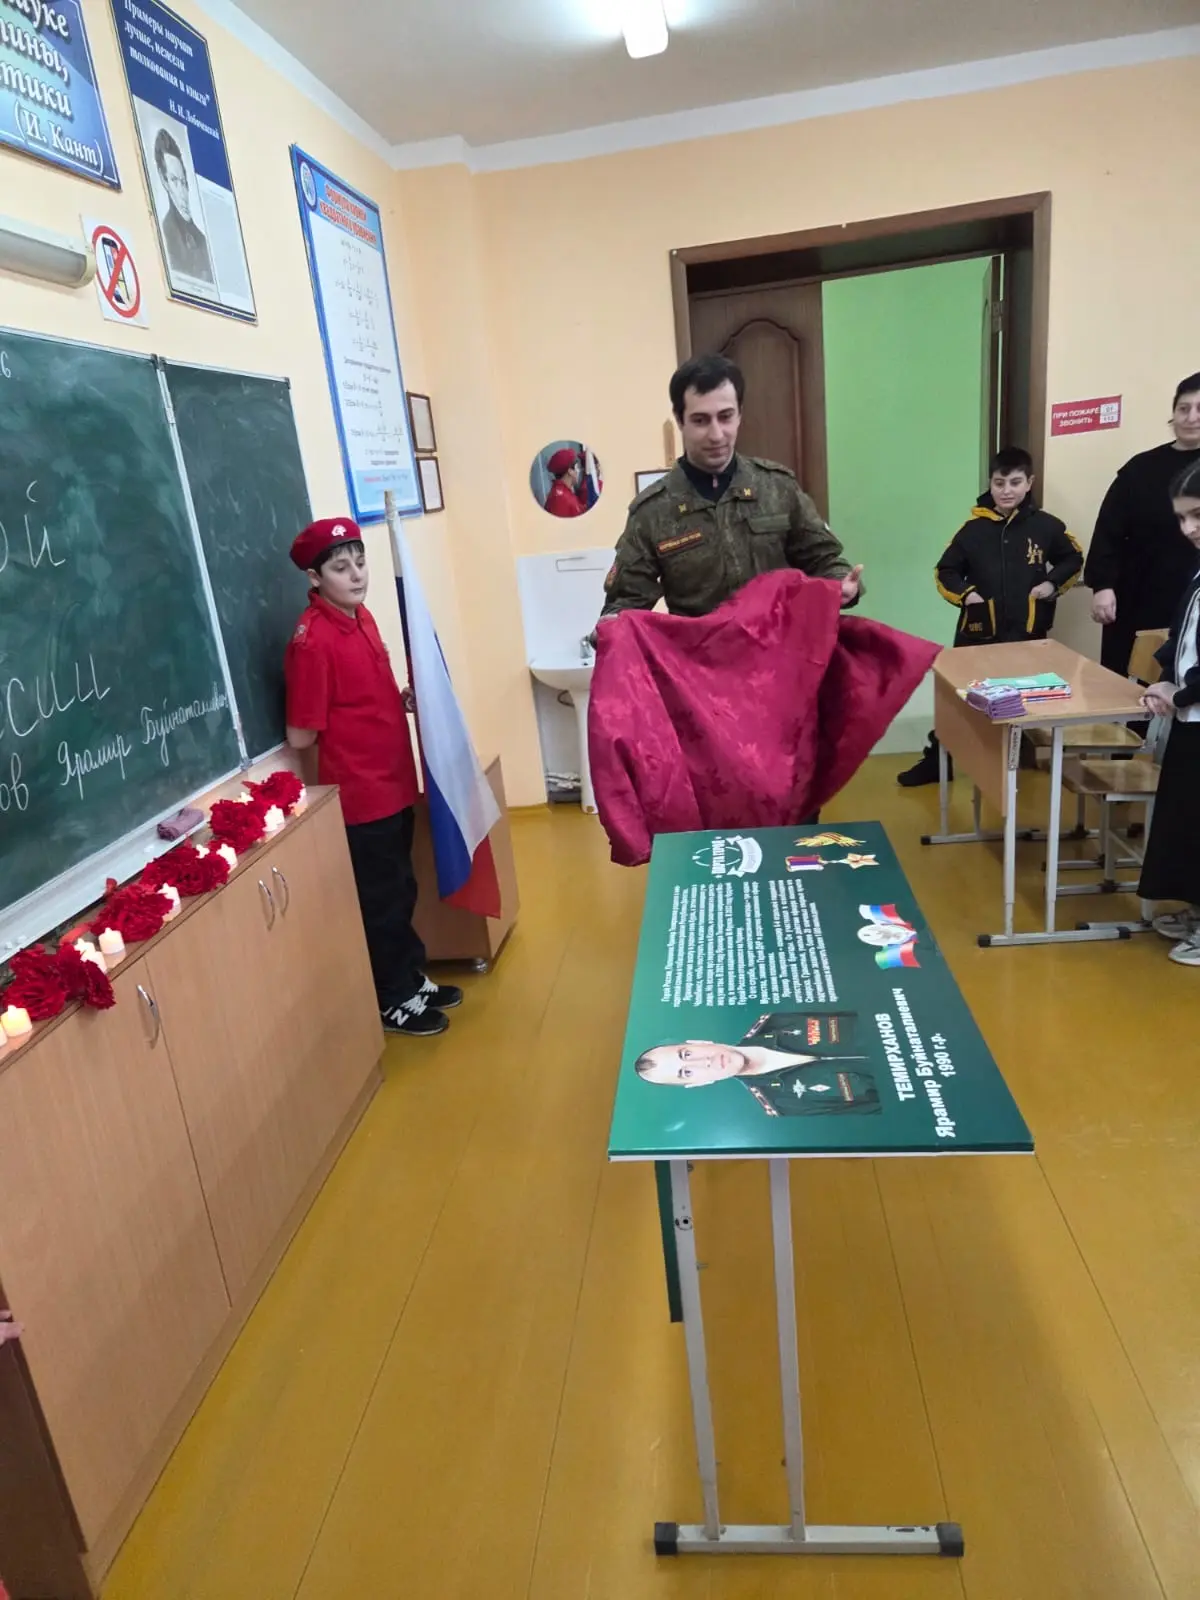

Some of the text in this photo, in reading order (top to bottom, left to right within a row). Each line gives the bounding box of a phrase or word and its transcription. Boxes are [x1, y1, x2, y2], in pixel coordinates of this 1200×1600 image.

[51, 122, 104, 176] Кант)
[1052, 411, 1068, 420] ПРИ
[0, 653, 111, 739] сии
[57, 733, 132, 800] Ярамир
[874, 1013, 916, 1101] ТЕМИРХАНОВ
[892, 987, 956, 1137] Ярамир Буйнаталиевич
[933, 1051, 956, 1077] 1990
